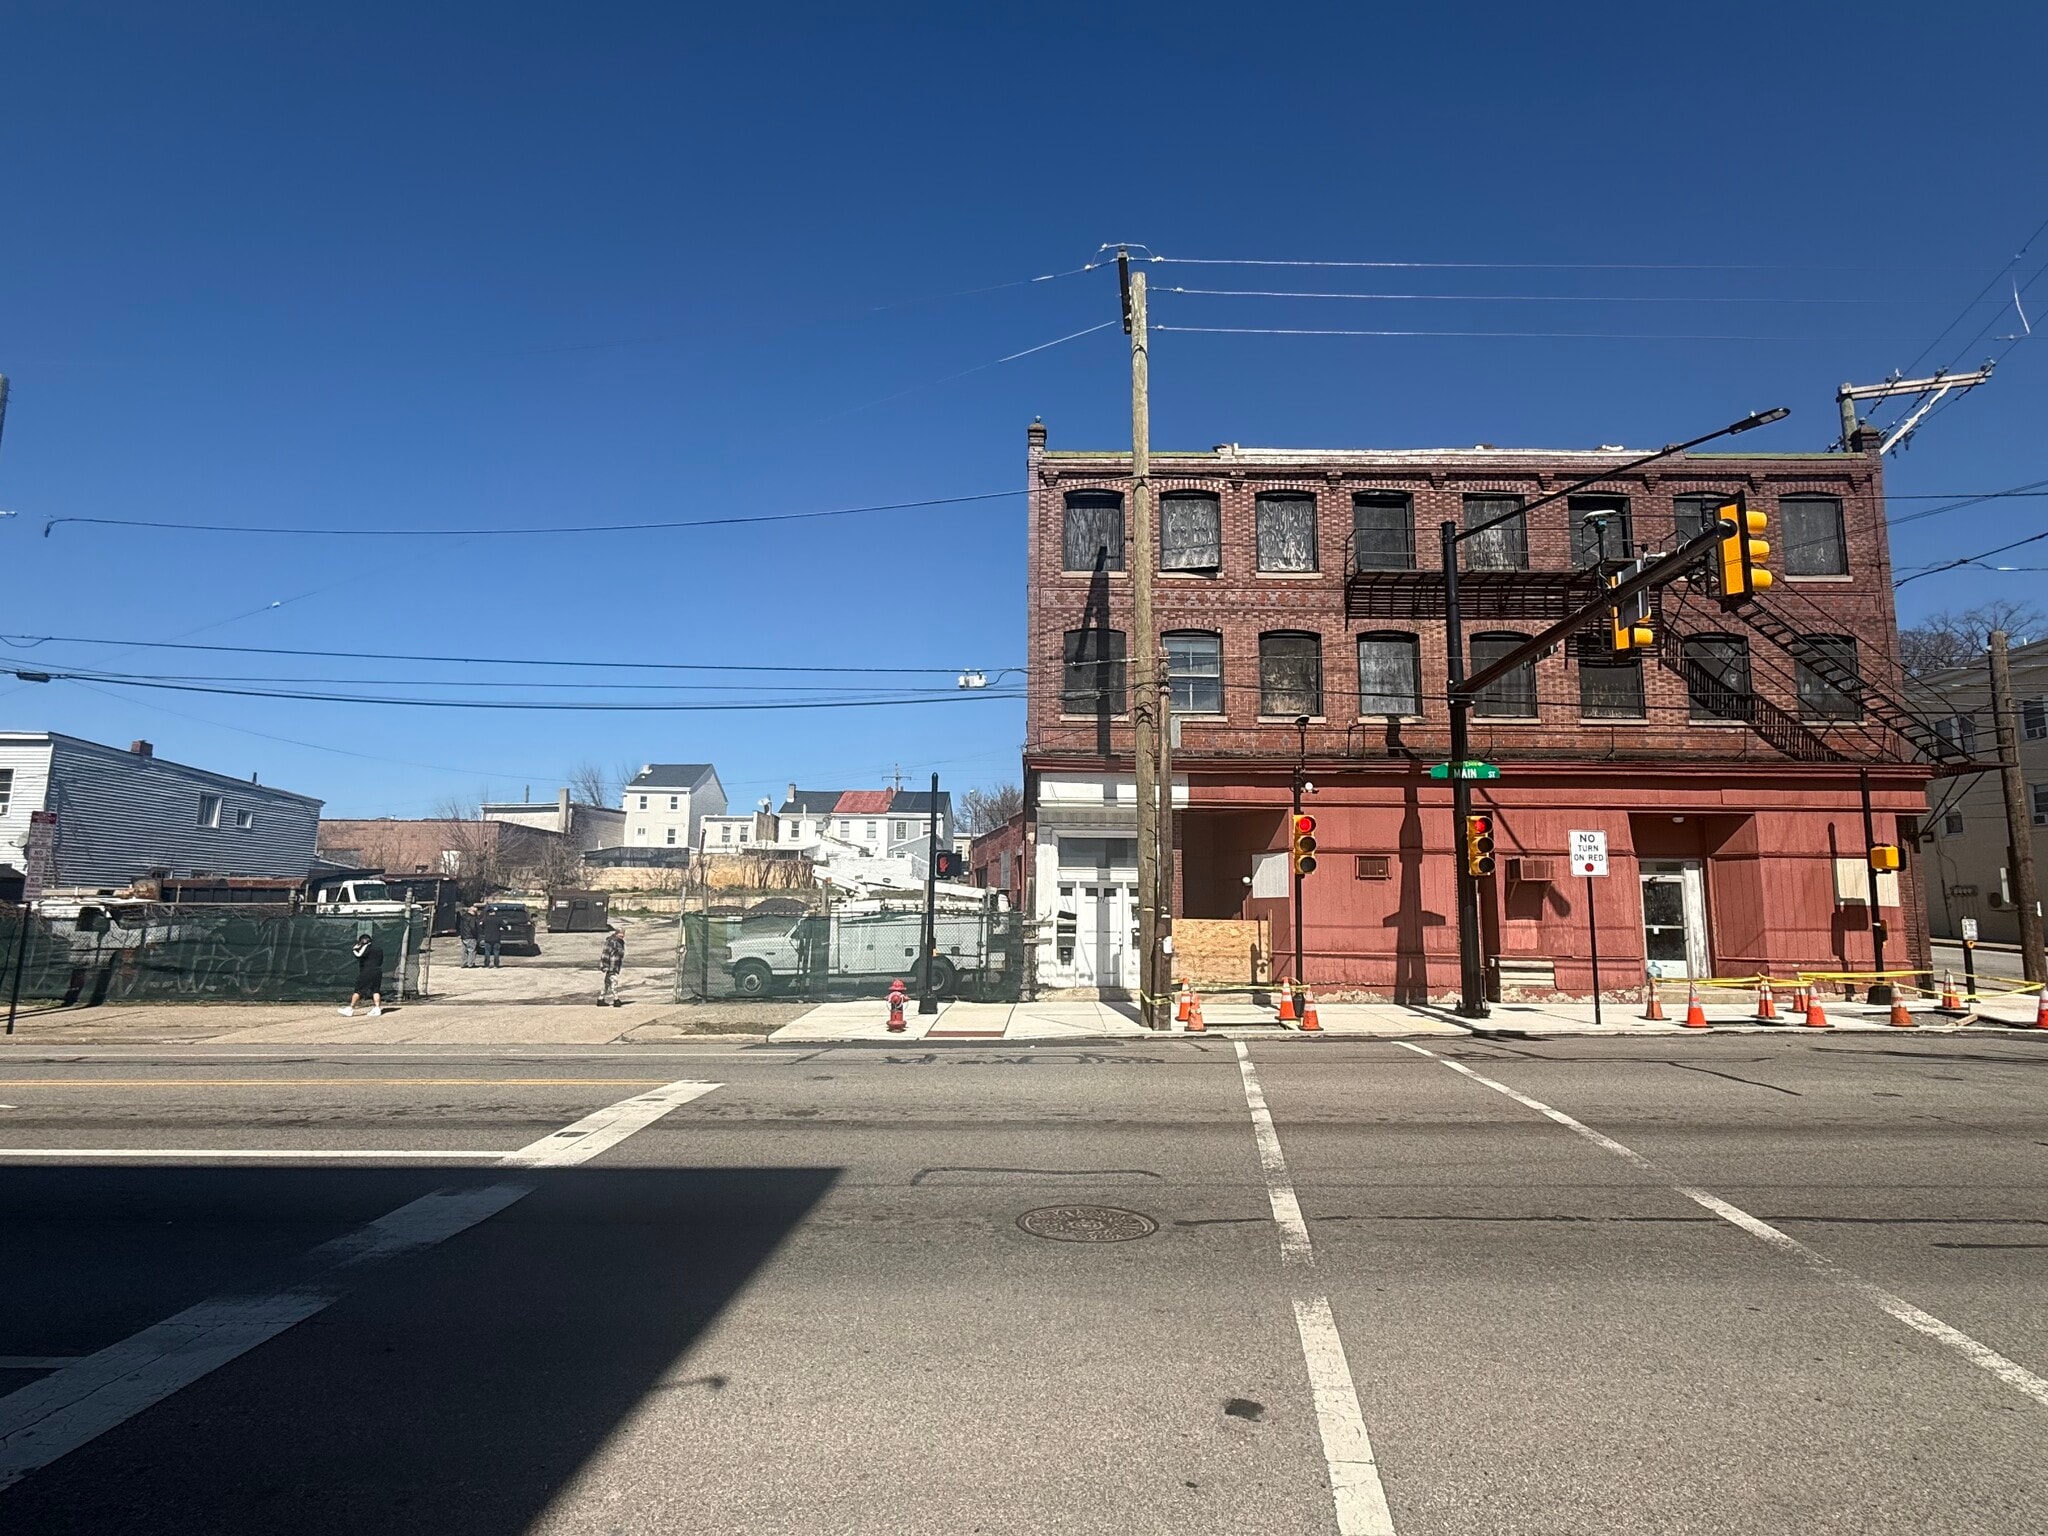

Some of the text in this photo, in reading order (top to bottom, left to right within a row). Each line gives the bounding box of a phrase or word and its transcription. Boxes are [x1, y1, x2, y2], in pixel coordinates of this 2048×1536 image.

[1453, 768, 1477, 779] MAIN
[1579, 834, 1595, 843] NO
[1577, 844, 1599, 852] TURN
[1573, 853, 1585, 861] ON
